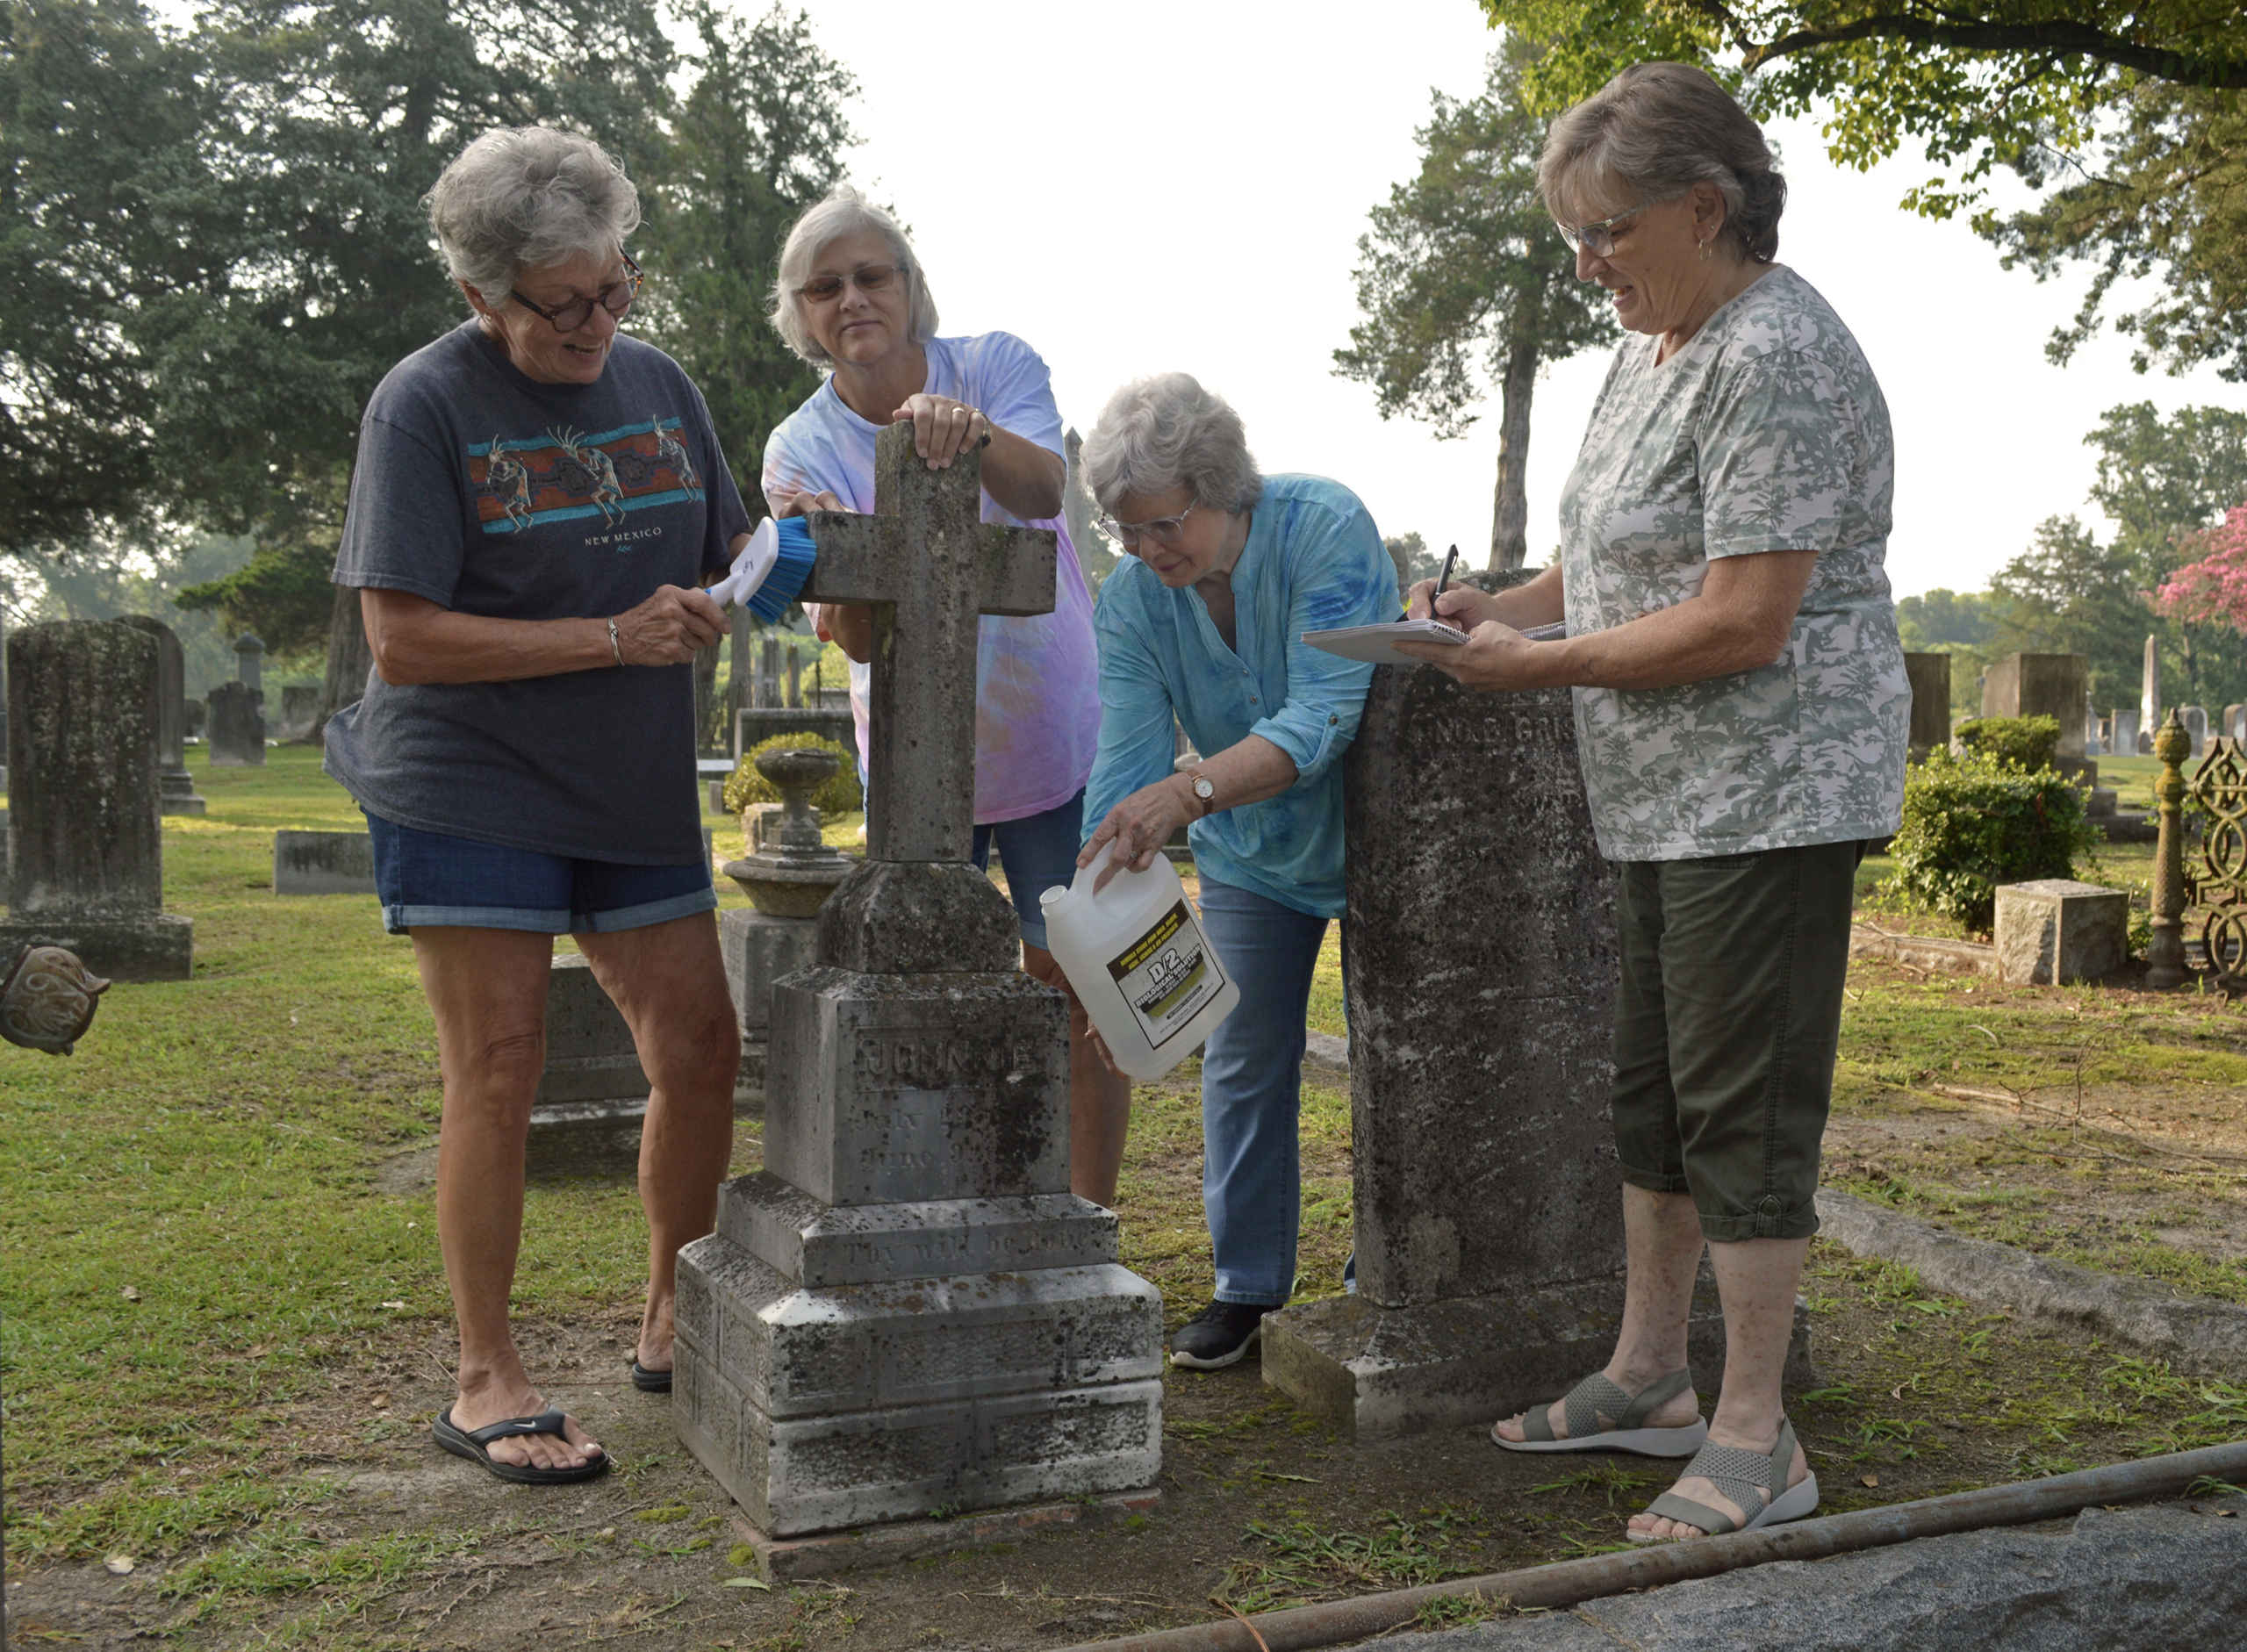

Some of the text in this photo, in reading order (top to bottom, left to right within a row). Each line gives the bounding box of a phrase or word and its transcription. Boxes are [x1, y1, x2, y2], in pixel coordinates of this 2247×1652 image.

[585, 527, 662, 546] NEW MEXICO
[1134, 973, 1174, 1009] BIOLOGICAL
[1172, 943, 1202, 975] SOLUTION
[1148, 948, 1181, 983] D/2
[854, 1108, 923, 1142] July
[859, 1146, 934, 1170] June
[842, 1239, 901, 1268] Thy
[912, 1231, 973, 1262] will
[985, 1231, 1016, 1255] be
